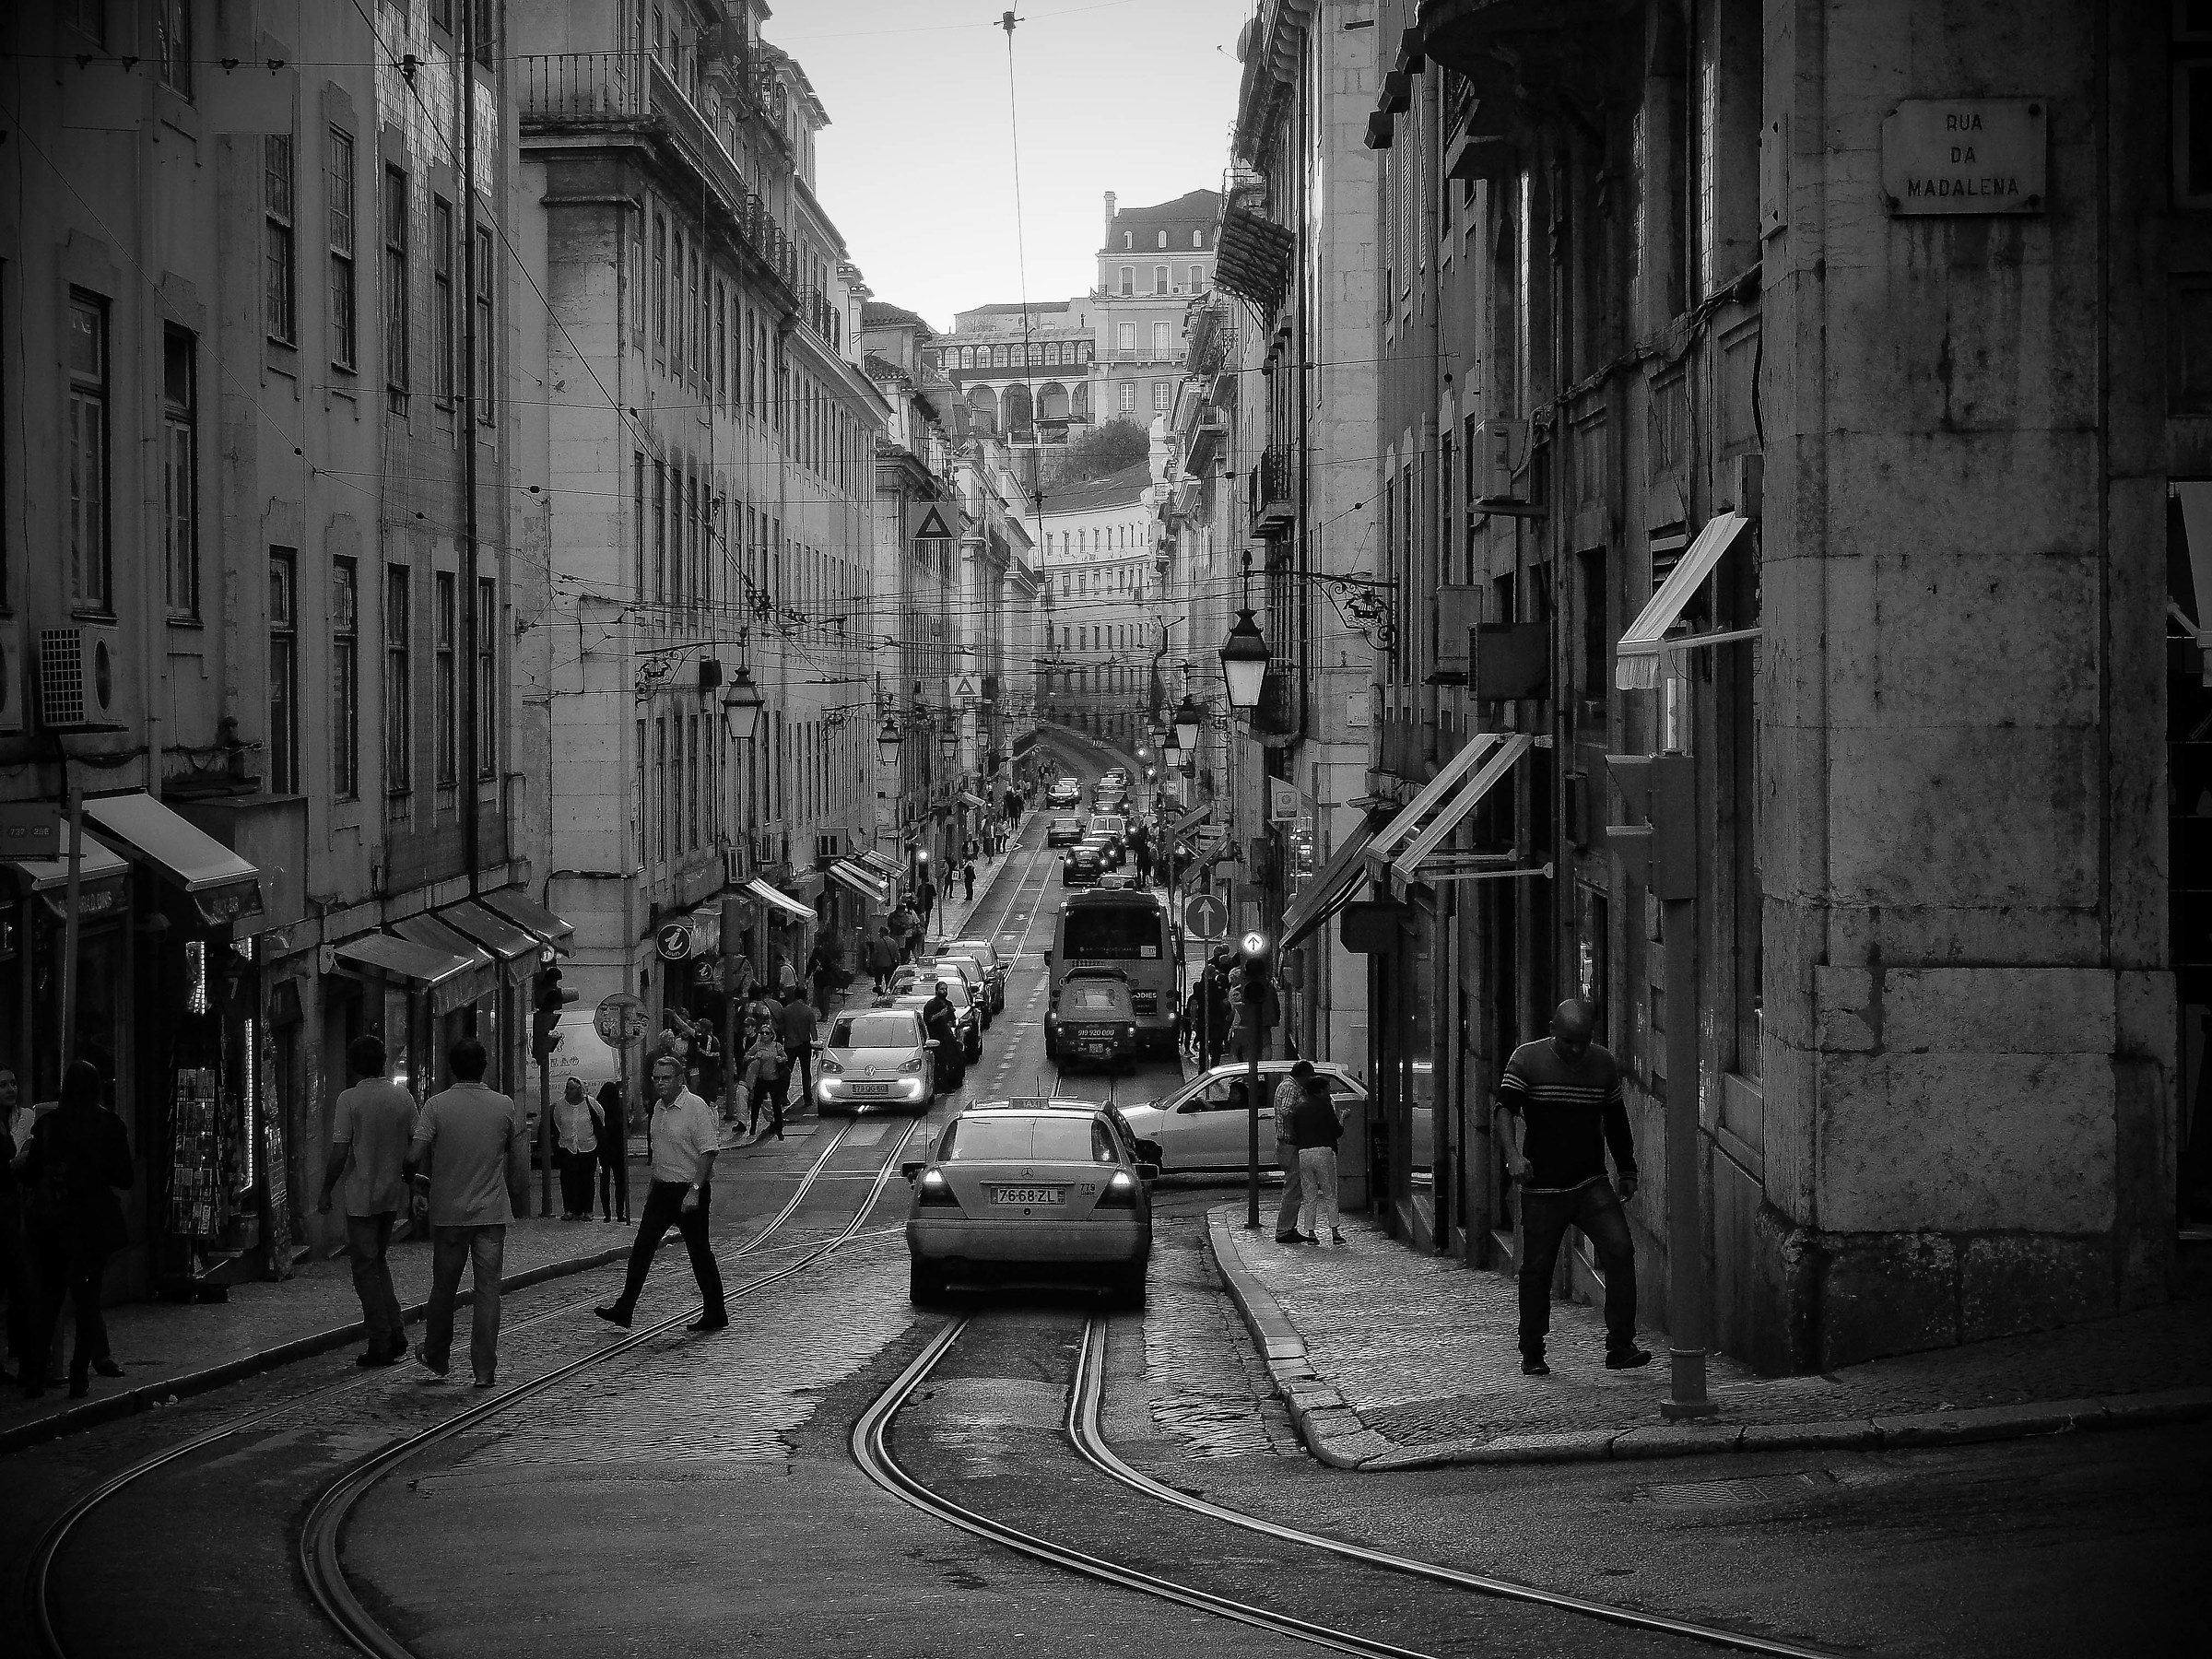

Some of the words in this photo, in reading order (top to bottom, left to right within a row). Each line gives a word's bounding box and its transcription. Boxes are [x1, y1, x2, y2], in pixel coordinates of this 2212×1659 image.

[1947, 114, 1983, 131] RUA
[1950, 147, 1976, 163] DA
[1908, 178, 2019, 196] MADALENA
[10, 828, 26, 836] 737
